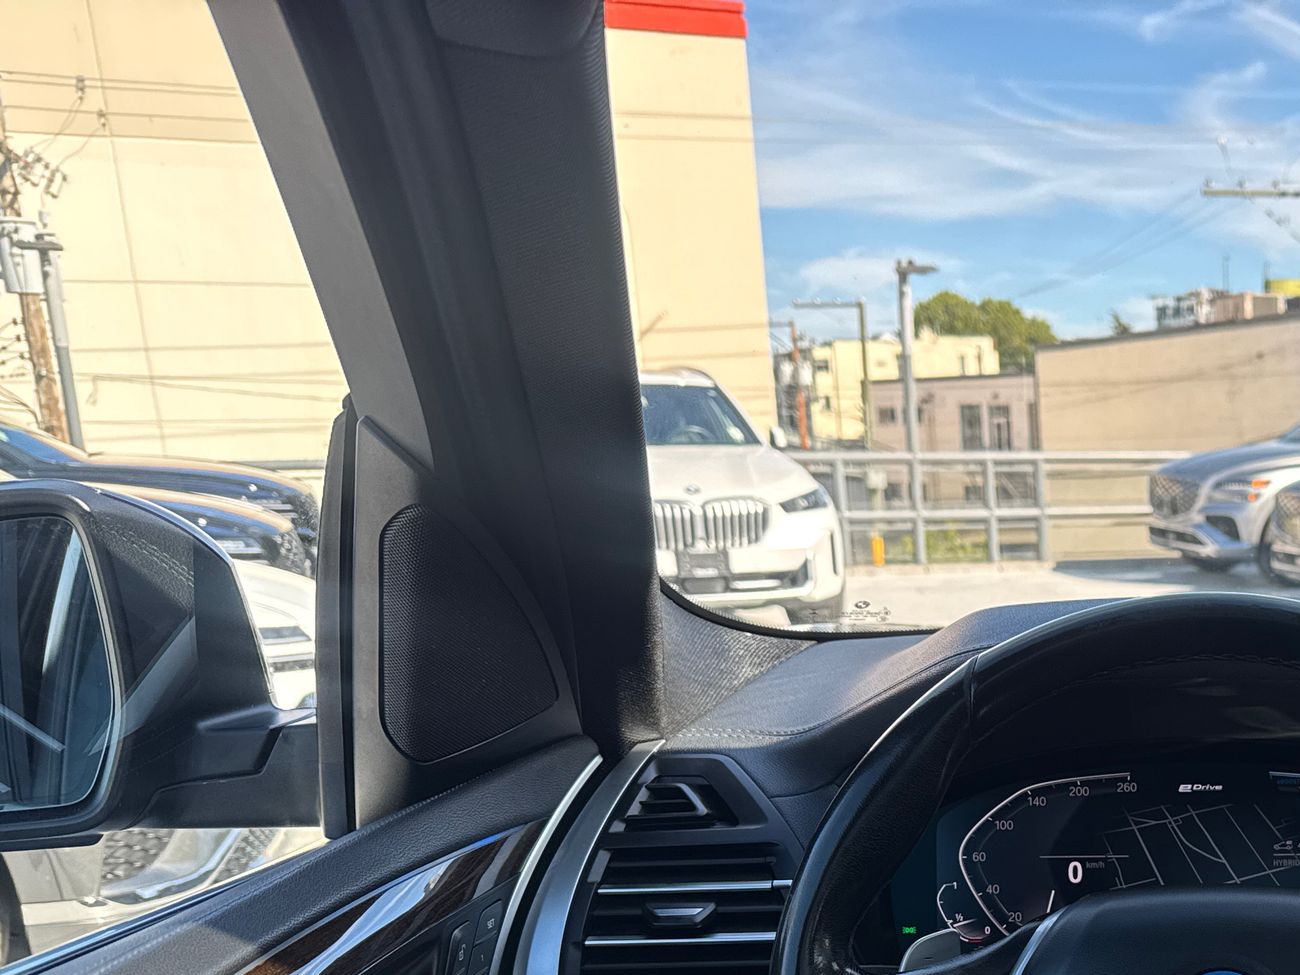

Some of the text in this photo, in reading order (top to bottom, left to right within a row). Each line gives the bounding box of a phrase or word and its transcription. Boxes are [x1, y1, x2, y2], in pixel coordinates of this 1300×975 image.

[1069, 786, 1090, 797] 200
[1117, 782, 1137, 793] 260
[1027, 797, 1047, 807] 140
[994, 820, 1014, 831] 100
[972, 852, 986, 862] 60
[1273, 859, 1300, 867] HYBRID
[1068, 860, 1105, 884] 0 km/h
[986, 884, 1000, 895] 40
[1008, 912, 1022, 923] 20
[486, 918, 495, 929] SET
[984, 926, 991, 935] 0
